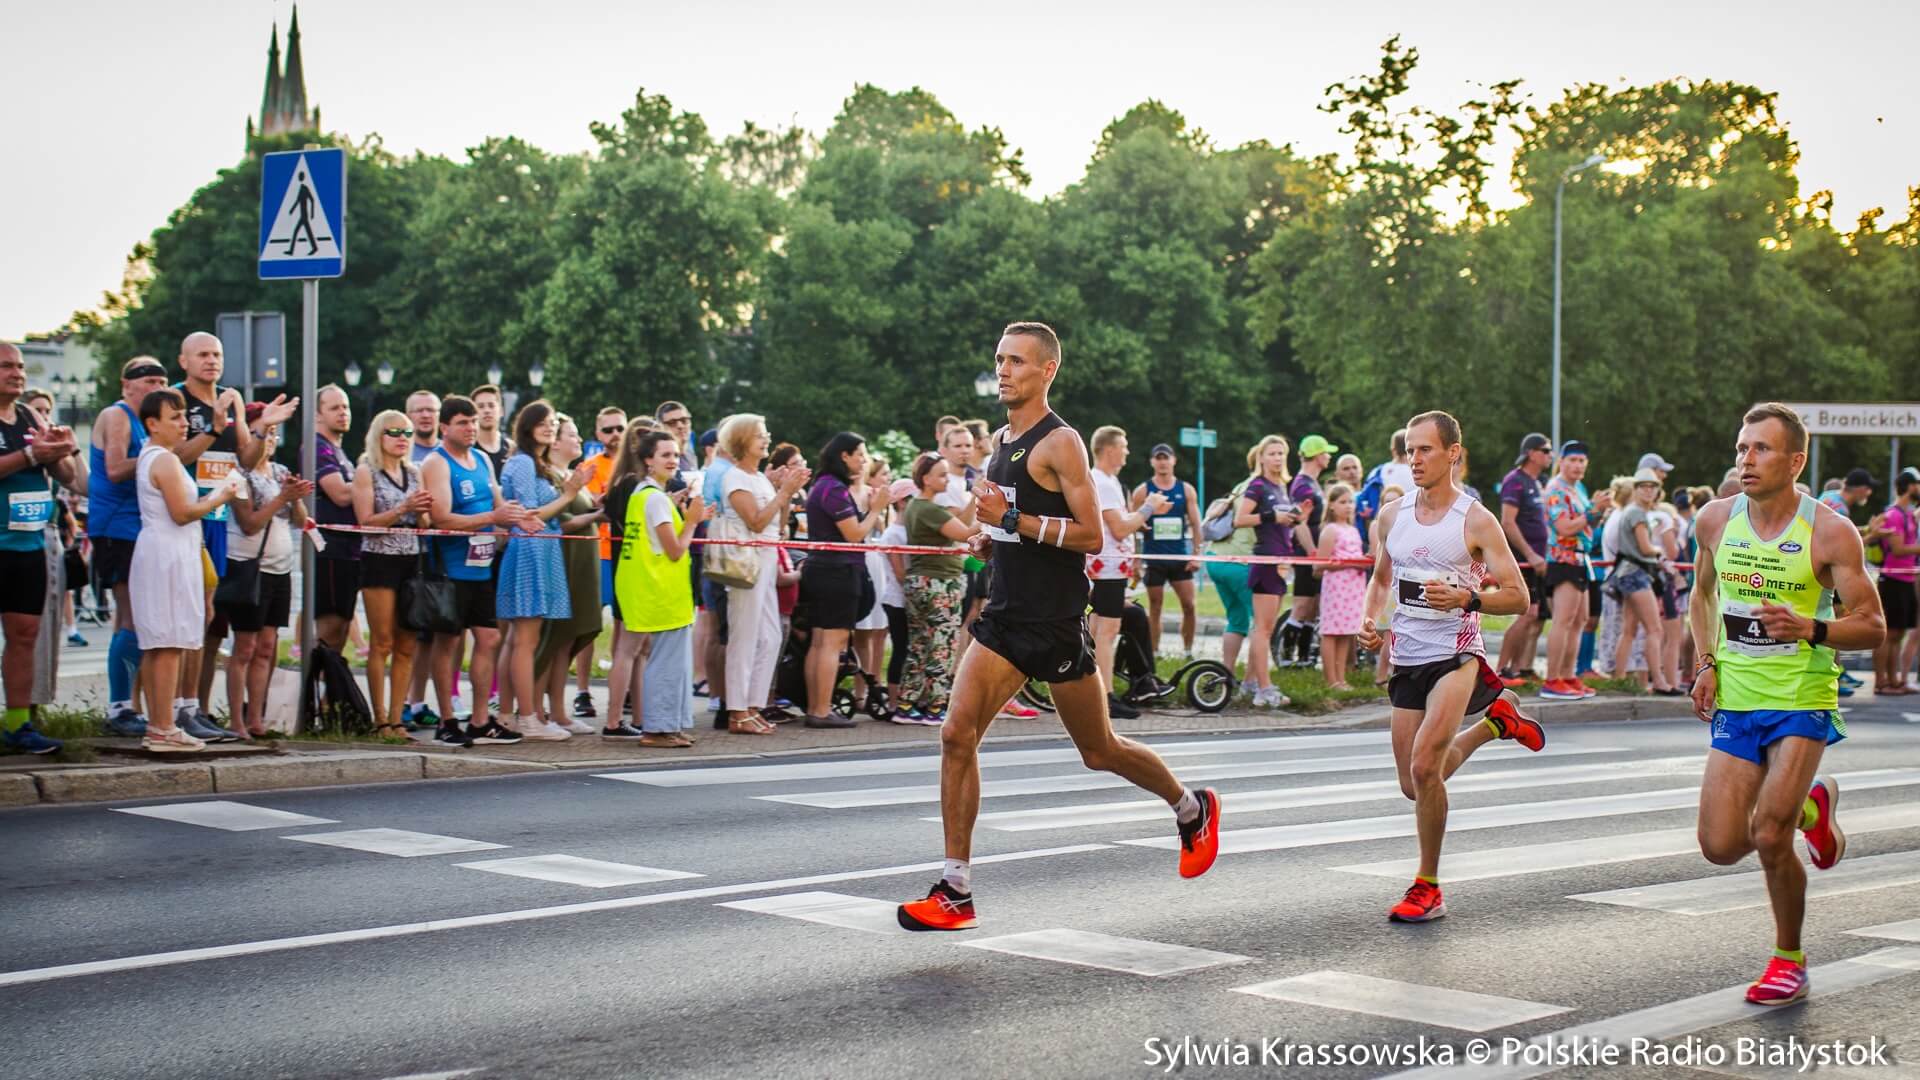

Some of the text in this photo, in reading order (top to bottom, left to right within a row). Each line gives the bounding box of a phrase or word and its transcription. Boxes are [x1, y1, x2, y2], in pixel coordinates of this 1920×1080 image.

[1818, 410, 1917, 427] Branickich
[17, 503, 46, 516] 3391
[1721, 572, 1807, 591] AGRO METAL
[1418, 585, 1426, 599] 2
[1747, 621, 1760, 636] 4
